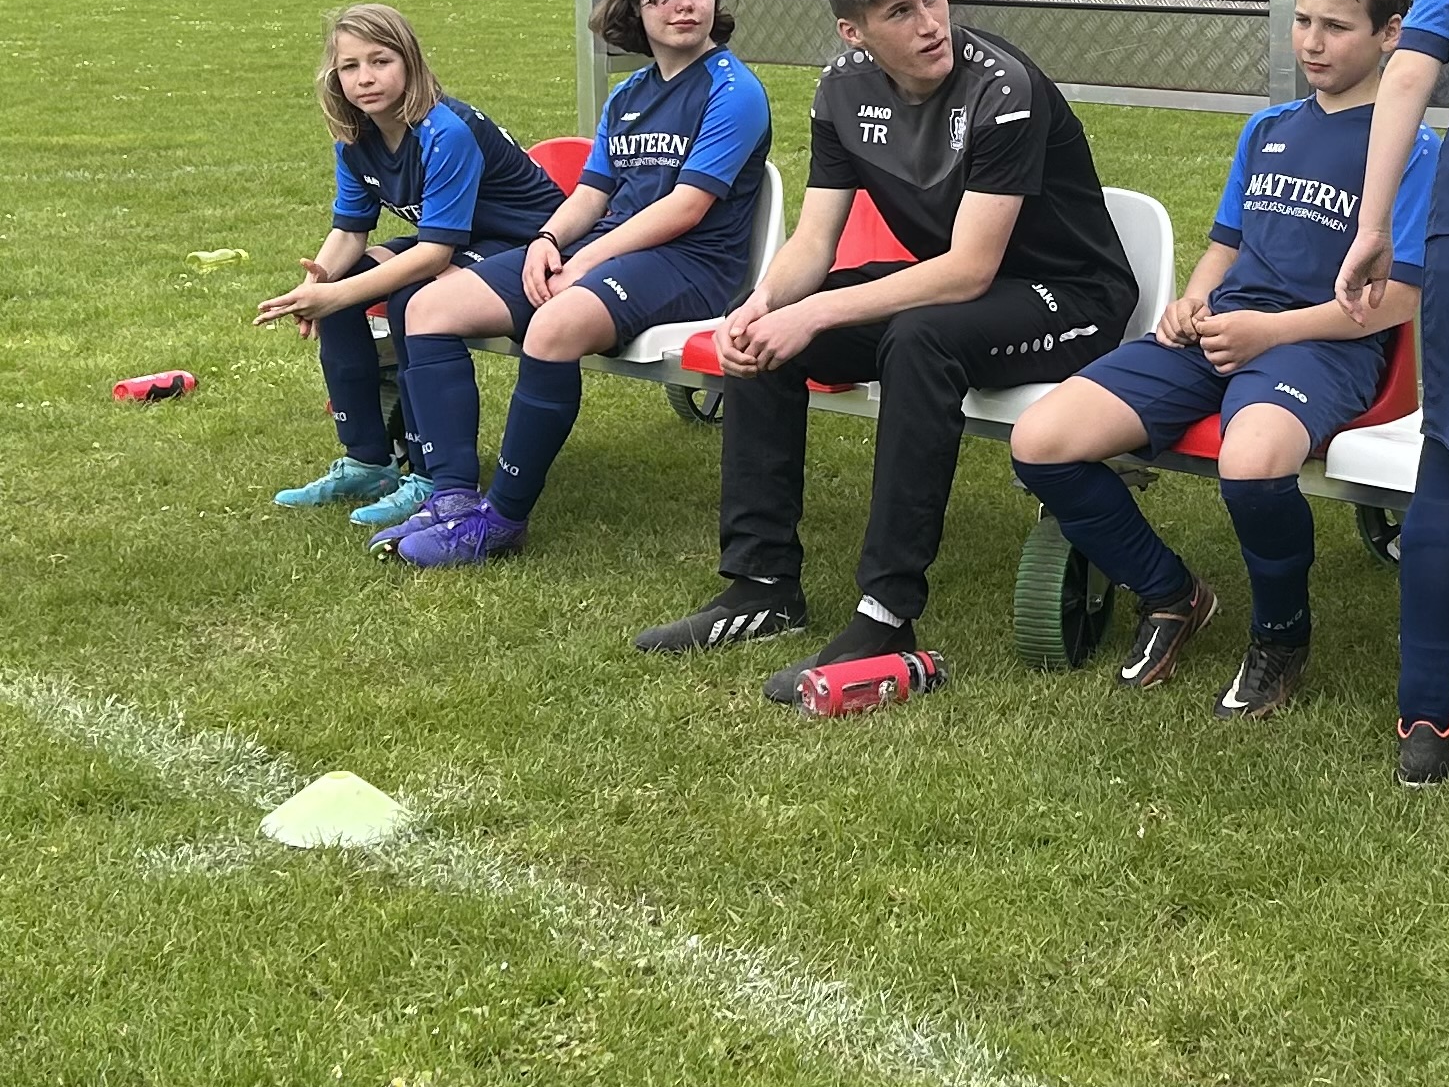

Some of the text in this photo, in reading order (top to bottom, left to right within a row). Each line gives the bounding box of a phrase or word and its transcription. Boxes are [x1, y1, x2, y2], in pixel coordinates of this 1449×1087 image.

[857, 105, 892, 120] JAKO
[608, 132, 690, 156] MATTERN
[859, 122, 888, 144] TR
[1244, 173, 1359, 218] MATTERN
[1031, 283, 1058, 312] JAKO
[1274, 381, 1308, 404] JAKO
